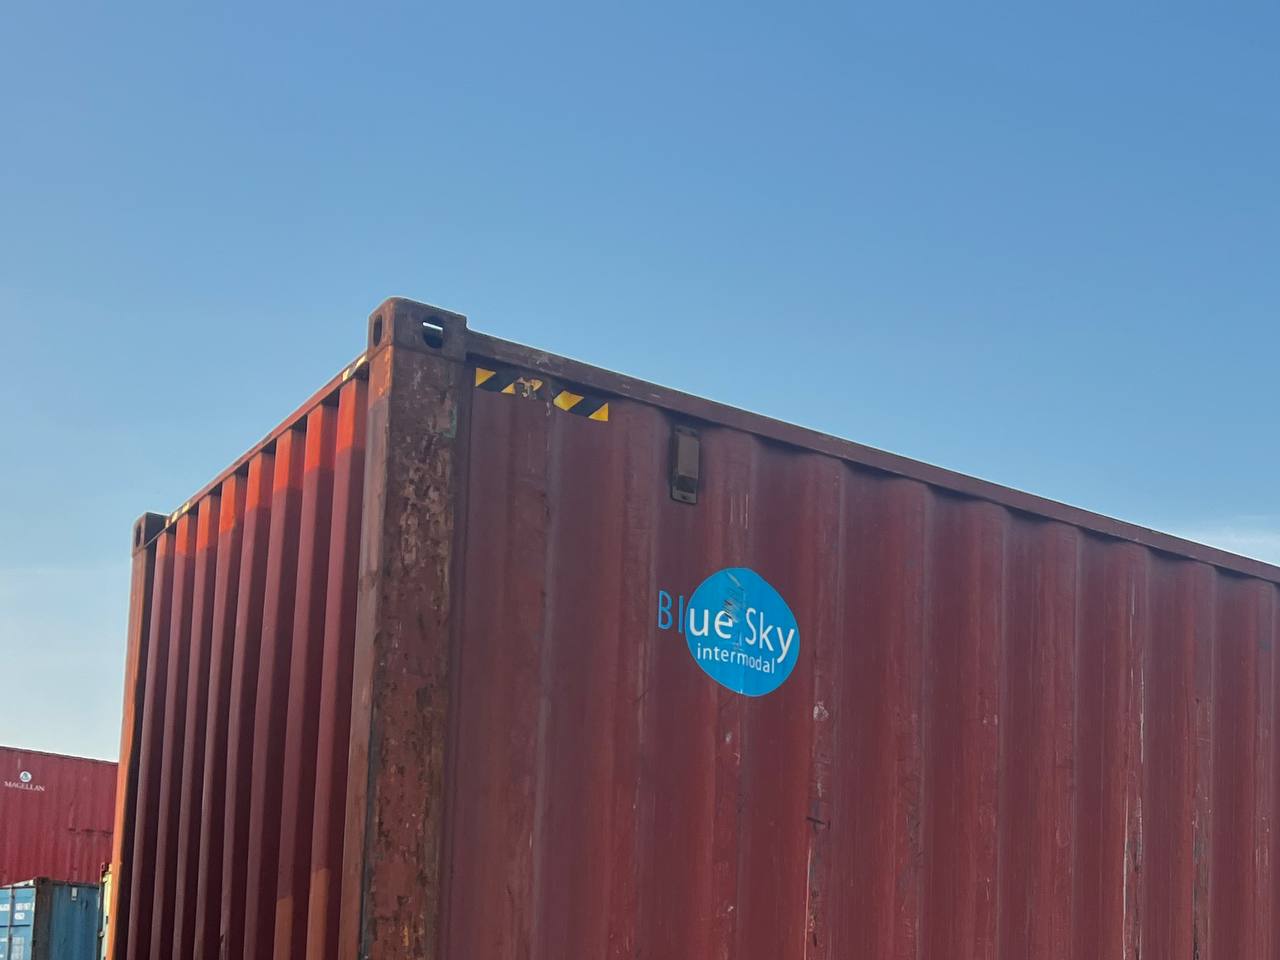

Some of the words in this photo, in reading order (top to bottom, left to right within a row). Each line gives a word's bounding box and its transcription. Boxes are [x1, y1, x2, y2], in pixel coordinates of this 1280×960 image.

[657, 590, 734, 639] Blue
[745, 607, 795, 663] Sky
[697, 643, 775, 674] intermodal
[4, 781, 45, 792] MAGELLAN
